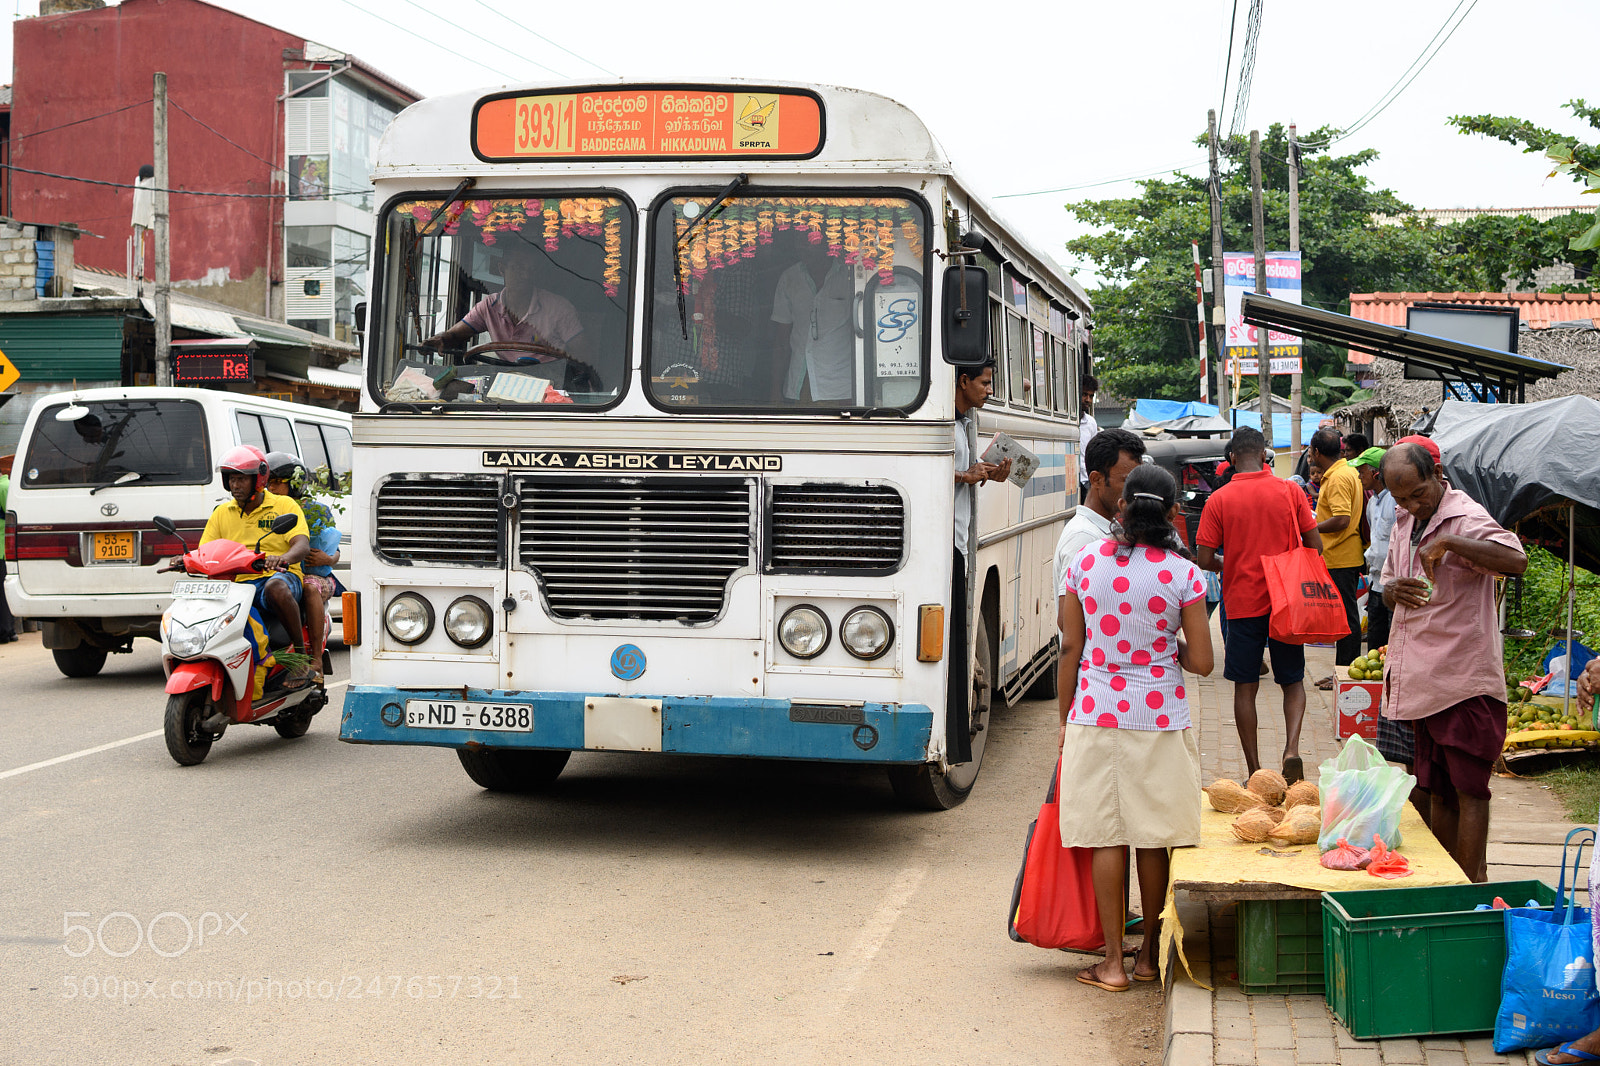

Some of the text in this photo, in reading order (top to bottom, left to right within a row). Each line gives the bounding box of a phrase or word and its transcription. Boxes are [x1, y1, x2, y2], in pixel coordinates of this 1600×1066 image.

[582, 95, 648, 117] බද්දේගම
[661, 95, 728, 116] හික්කඩුව
[518, 98, 575, 150] 393/1
[587, 117, 642, 133] பத்தேகம
[665, 116, 722, 133] ஹிக்கடுவ
[581, 138, 647, 151] BADDEGAMA
[661, 138, 727, 151] HIKKADUWA
[223, 359, 246, 376] Re
[483, 452, 781, 470] LANKA ASHOK LEYLAND
[101, 545, 127, 557] 9105
[428, 704, 456, 725] ND
[480, 706, 530, 728] 6388
[807, 708, 861, 721] VIKING
[1542, 988, 1576, 1000] Meso
